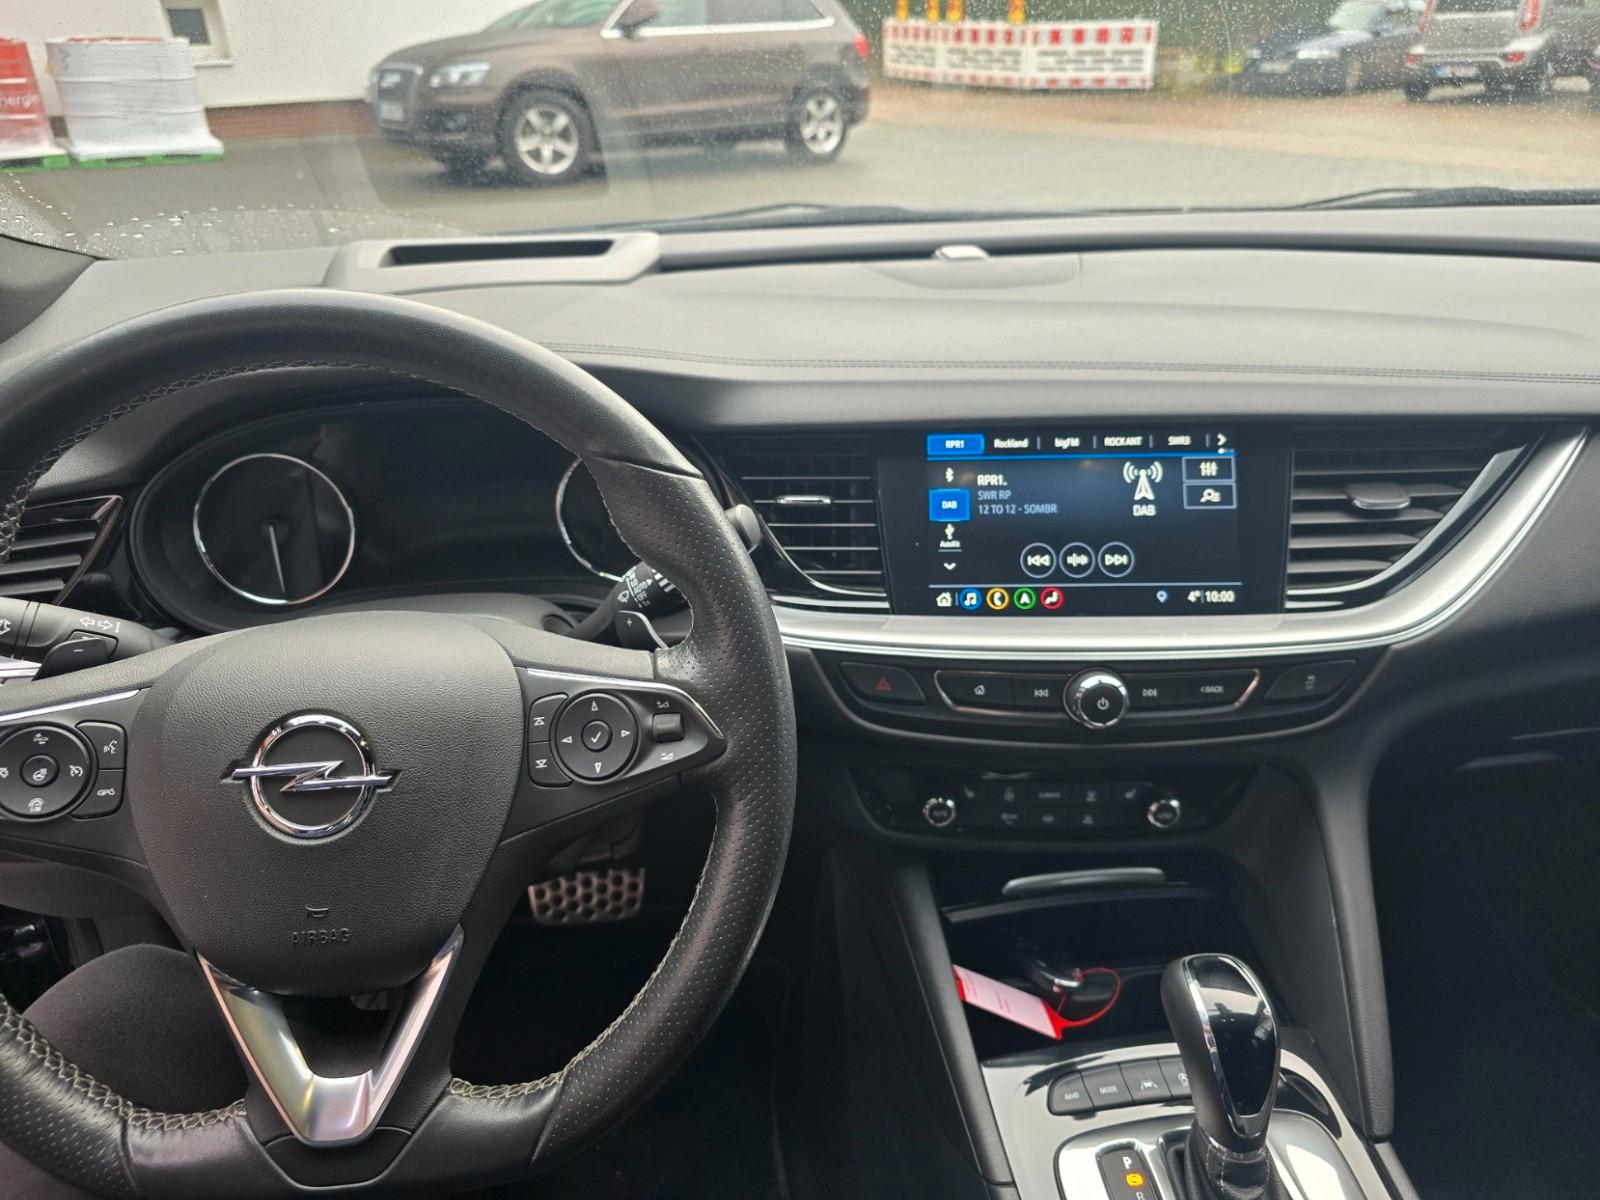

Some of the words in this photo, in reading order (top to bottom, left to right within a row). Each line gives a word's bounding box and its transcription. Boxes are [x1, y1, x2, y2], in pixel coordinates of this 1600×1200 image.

[945, 440, 965, 448] RPR1
[993, 438, 1029, 448] Rockland
[977, 474, 1008, 486] RPR1.
[978, 490, 997, 501] SWR
[999, 490, 1012, 500] RP
[941, 500, 958, 509] DAB
[979, 504, 989, 514] 12
[992, 504, 1003, 514] TO
[1006, 504, 1016, 514] 12
[1024, 503, 1059, 514] SOMBR
[1132, 504, 1157, 516] DAB
[1205, 590, 1235, 602] 10:00
[288, 927, 350, 944] AIRBAG
[1122, 1156, 1132, 1170] P
